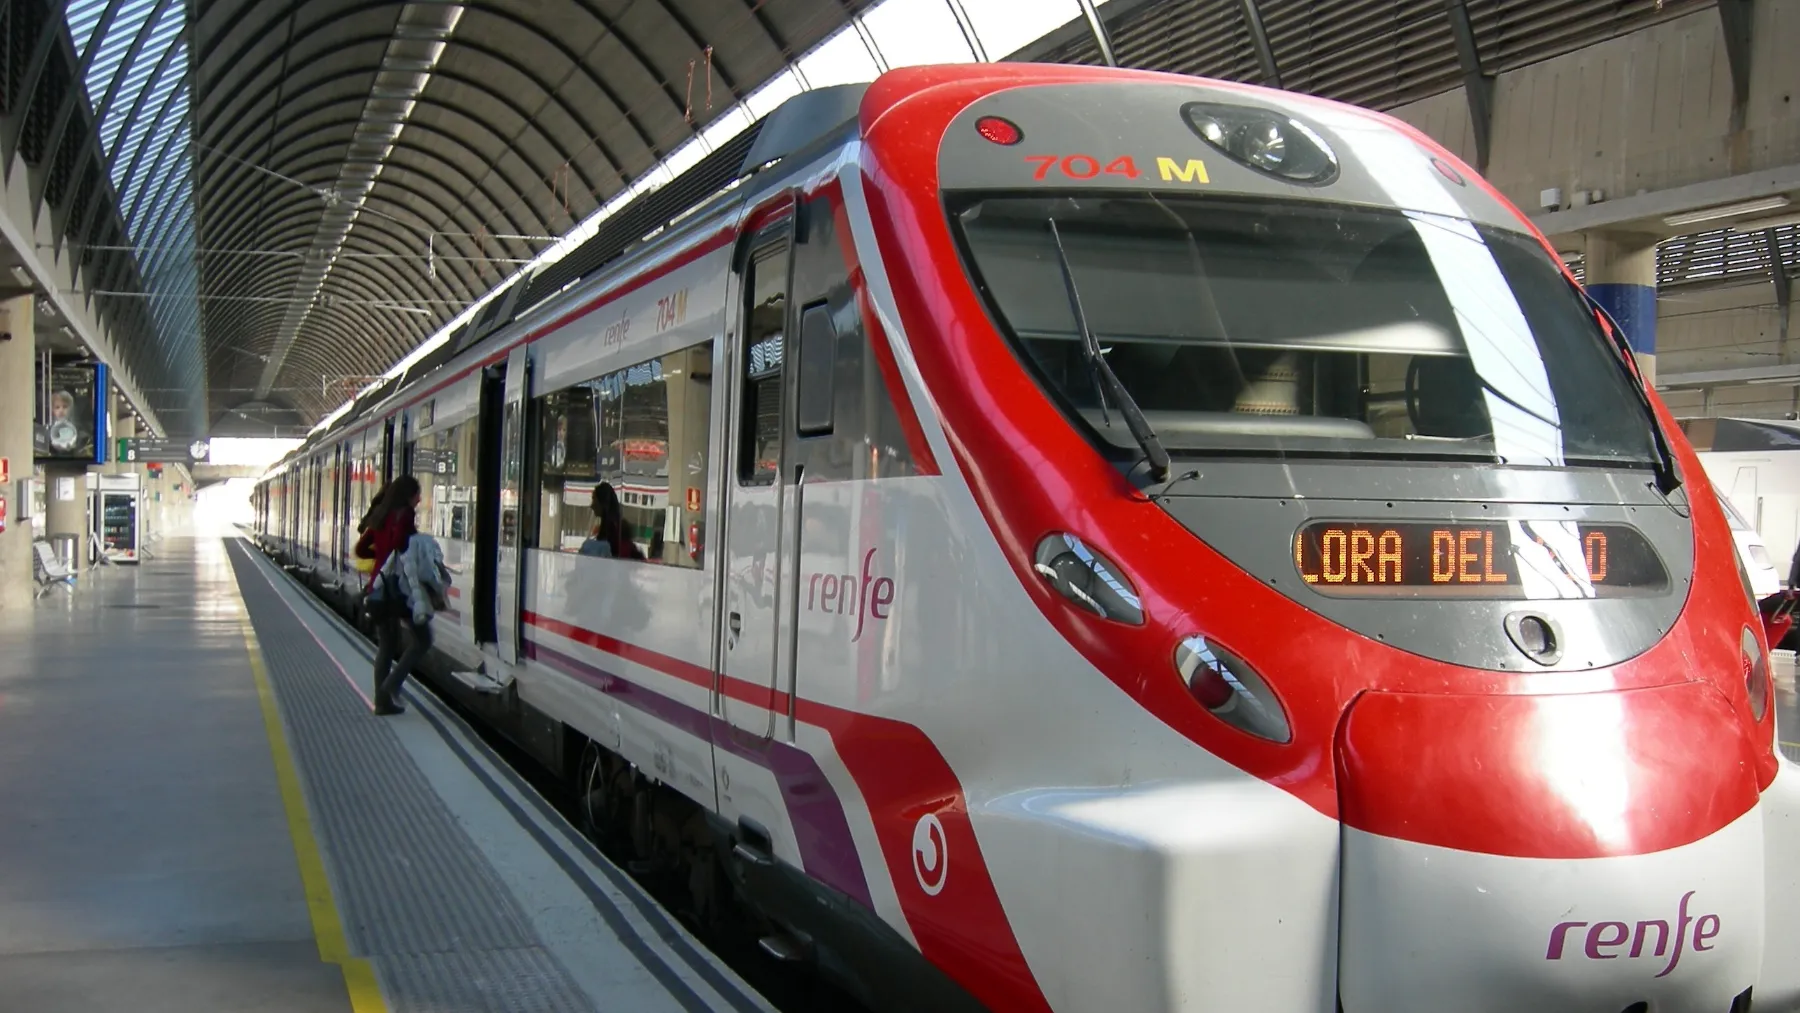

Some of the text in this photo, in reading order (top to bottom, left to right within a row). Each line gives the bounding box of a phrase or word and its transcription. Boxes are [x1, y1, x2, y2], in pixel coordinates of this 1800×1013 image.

[1024, 154, 1210, 184] 704 M
[604, 307, 631, 354] renfe
[128, 449, 136, 461] 8
[1297, 530, 1402, 583] LORA
[1432, 530, 1508, 583] DEL
[807, 547, 895, 643] renfe
[1545, 890, 1721, 979] renfe
